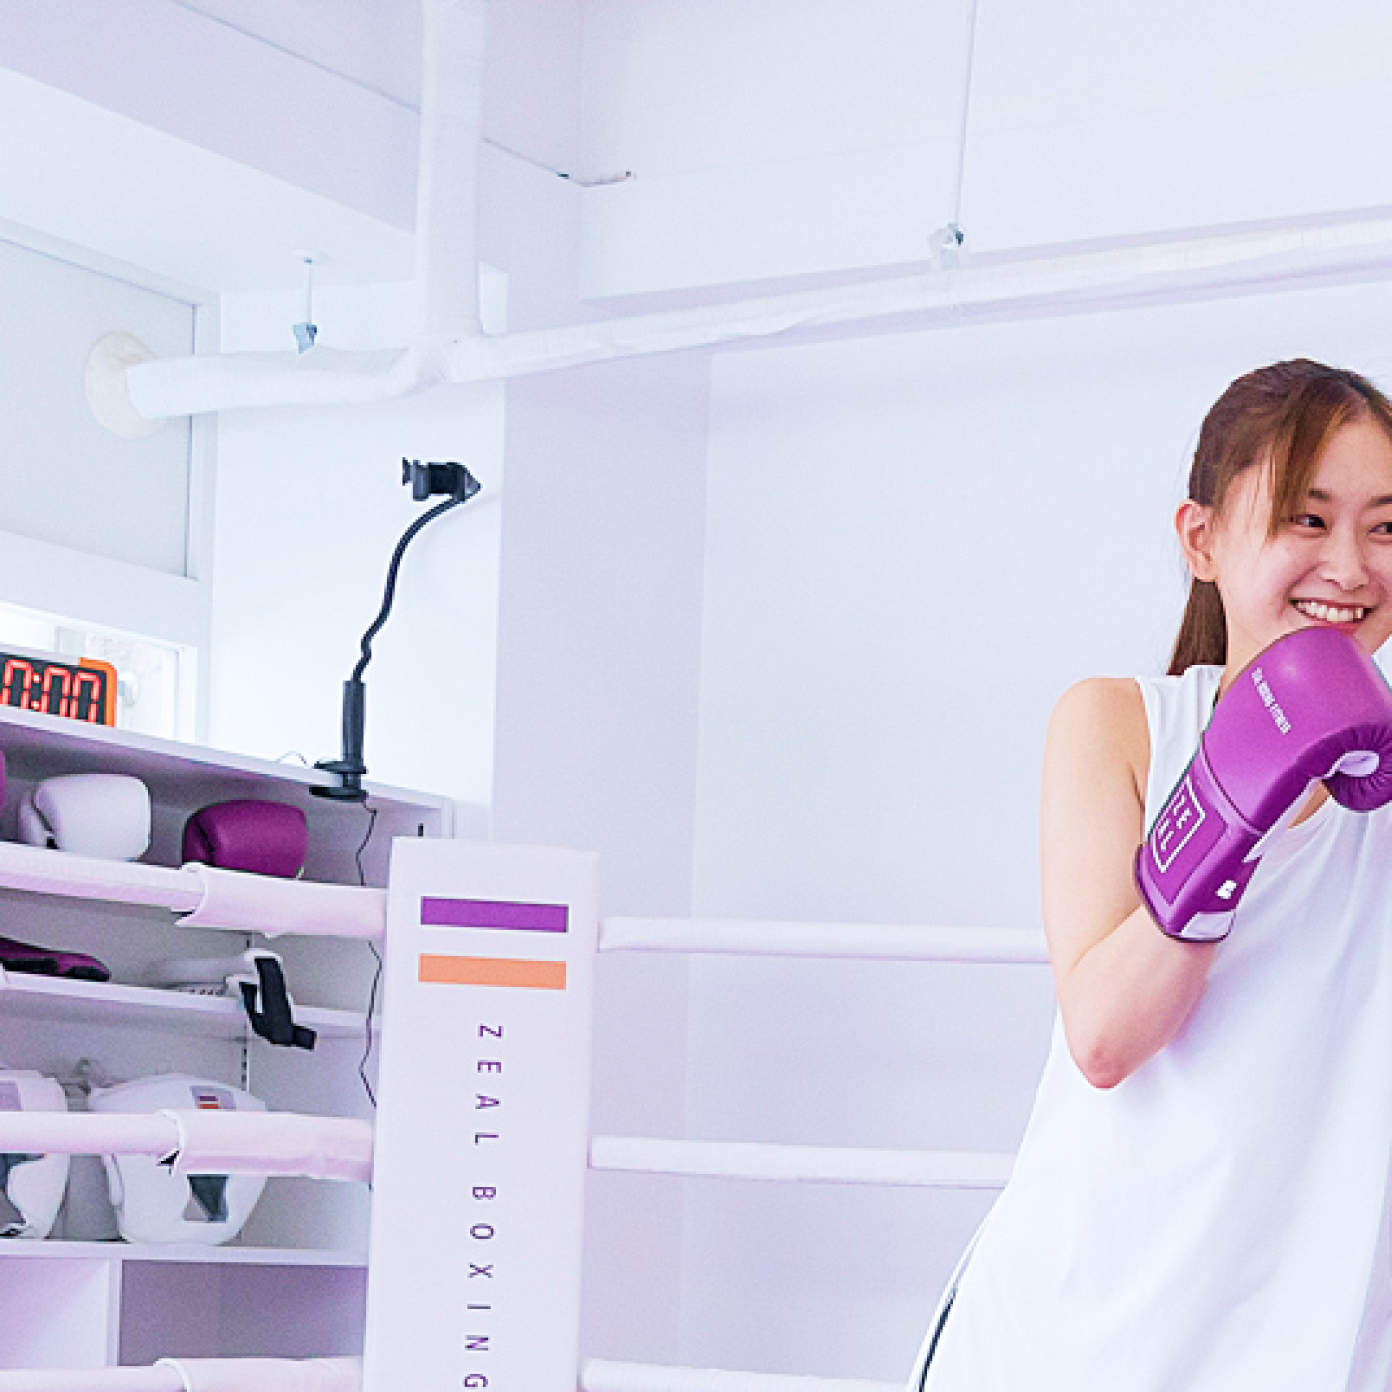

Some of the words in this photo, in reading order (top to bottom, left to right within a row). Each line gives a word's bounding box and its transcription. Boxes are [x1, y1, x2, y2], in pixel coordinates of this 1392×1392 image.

[1, 659, 101, 722] 0:00
[474, 1025, 503, 1146] ZEAL
[463, 1186, 497, 1389] BOXING
